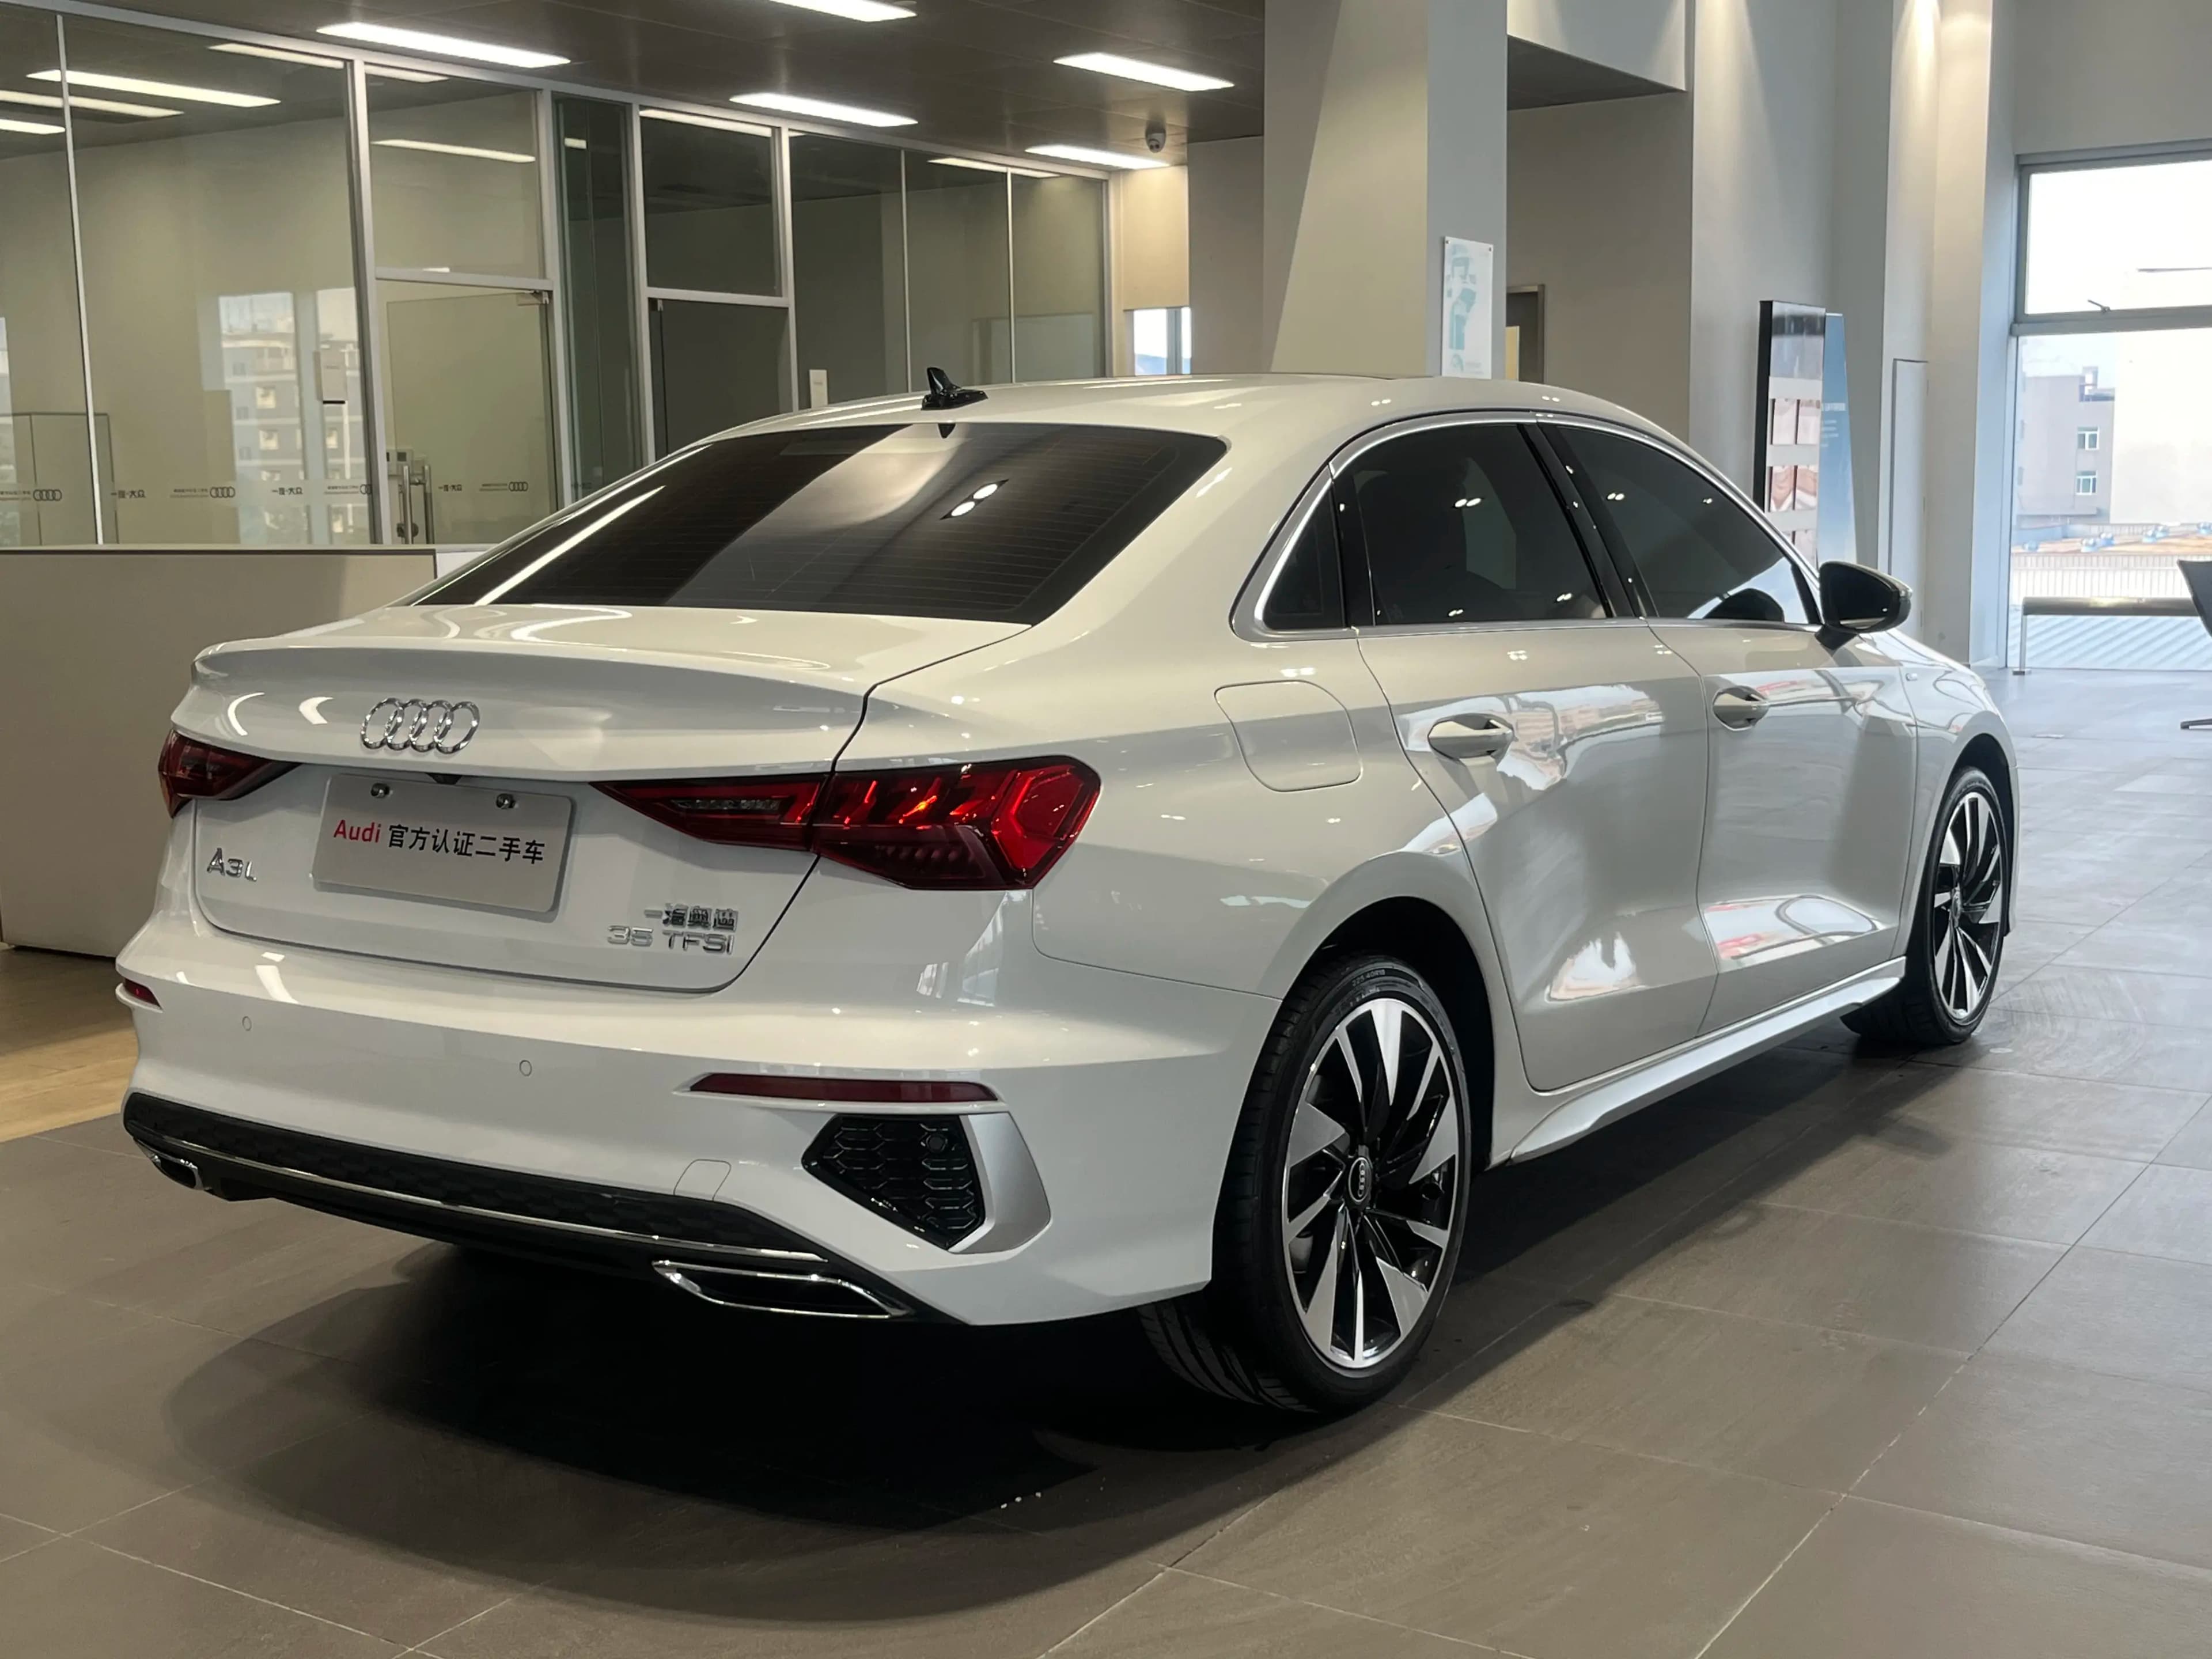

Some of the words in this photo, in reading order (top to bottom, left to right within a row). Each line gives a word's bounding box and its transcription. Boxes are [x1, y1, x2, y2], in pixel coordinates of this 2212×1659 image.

[333, 820, 381, 843] Audi
[388, 824, 546, 865] 官方认证二手车
[206, 847, 257, 882] A3L
[607, 925, 654, 947] 35
[662, 929, 735, 955] TFSI
